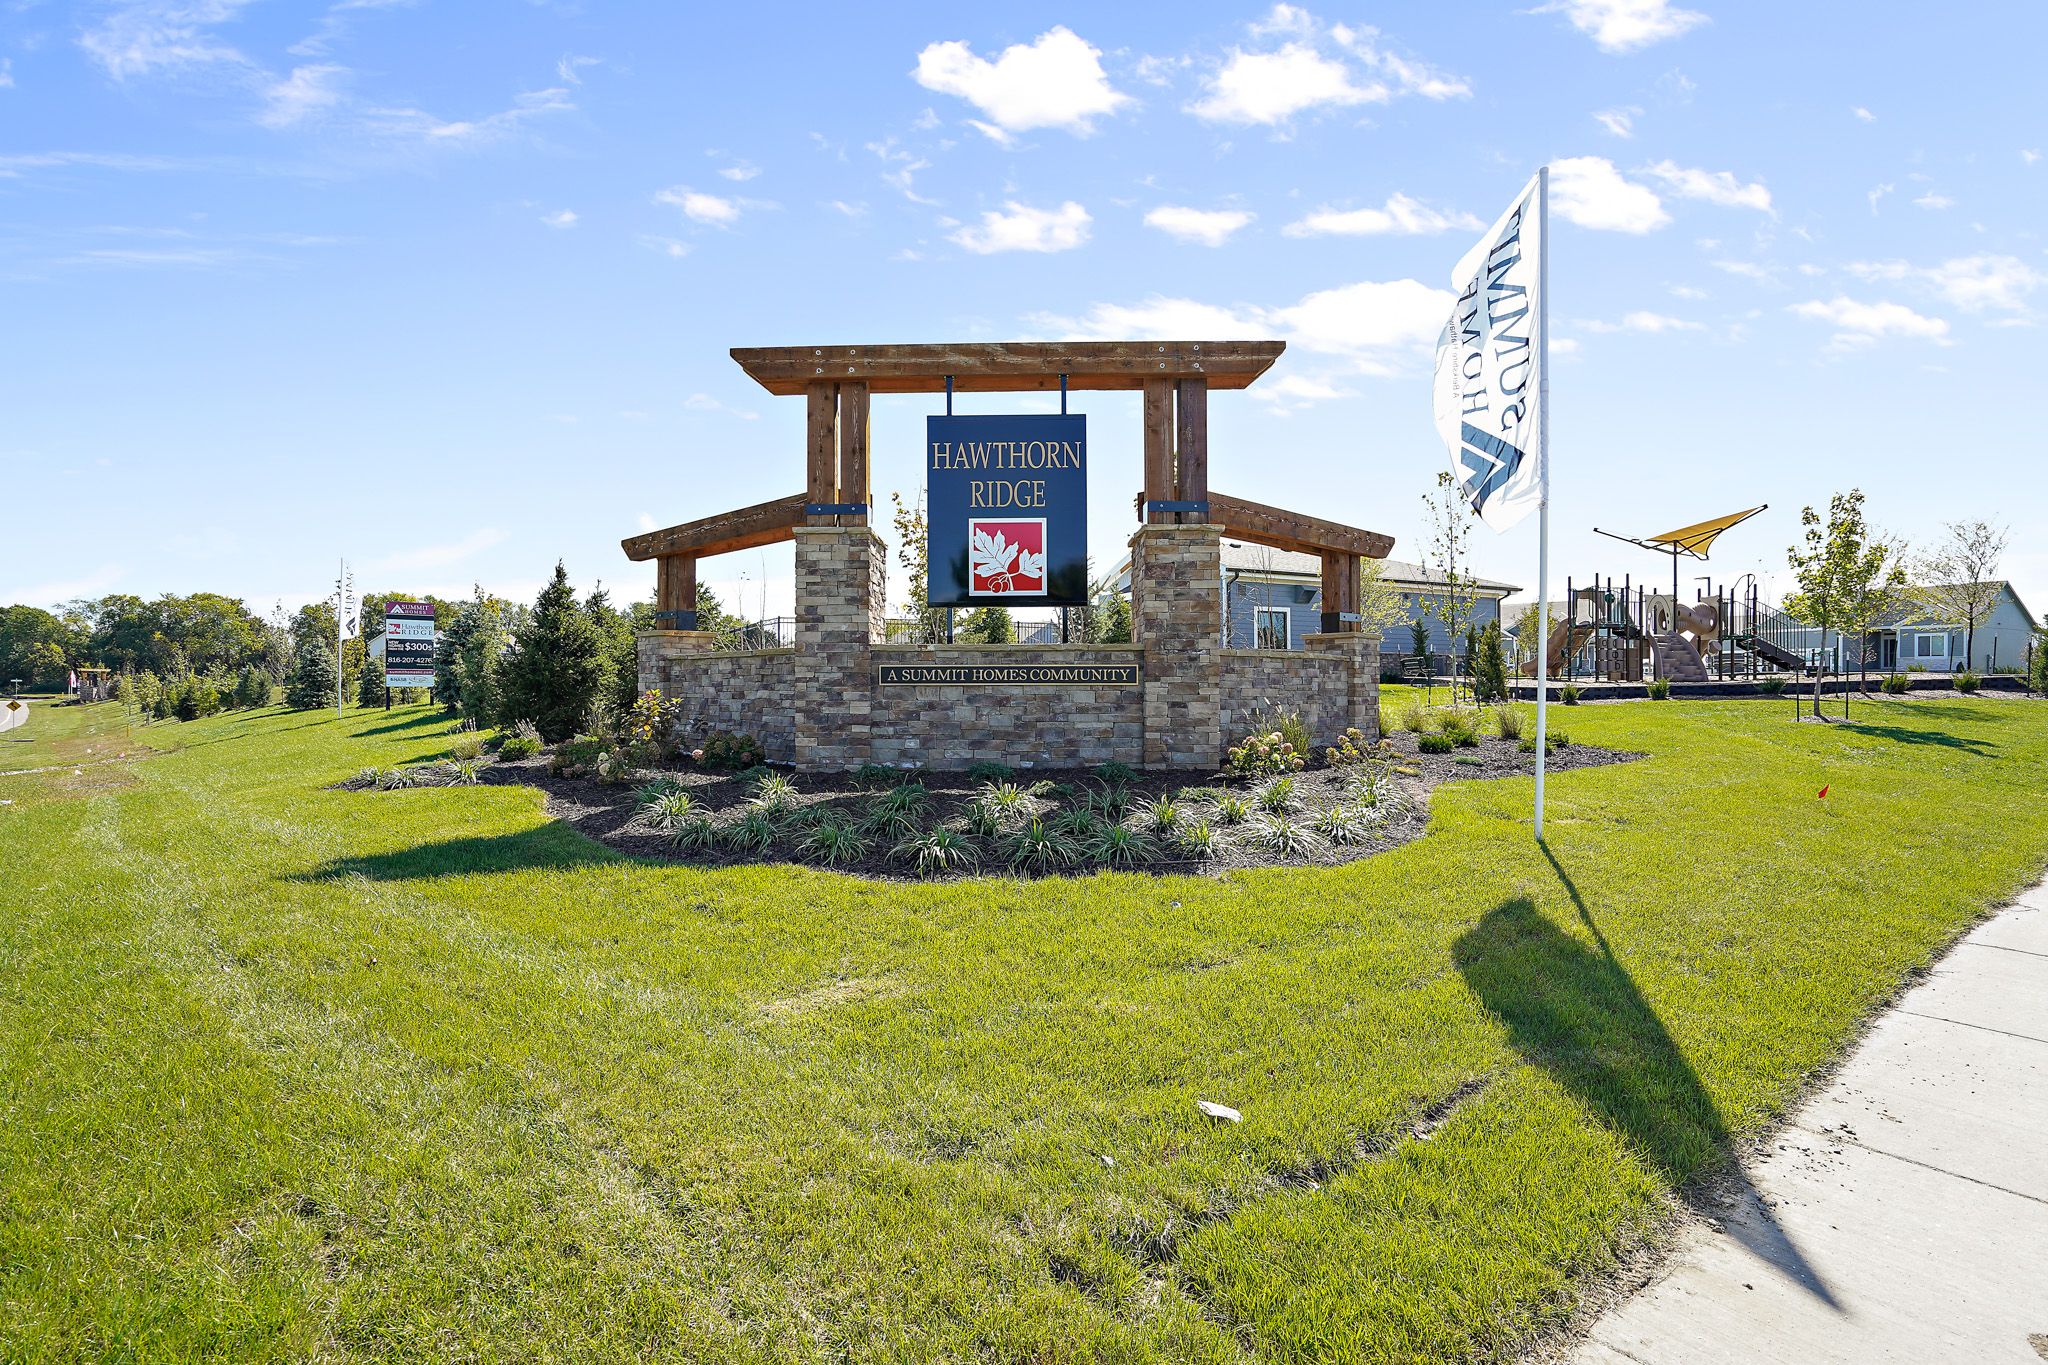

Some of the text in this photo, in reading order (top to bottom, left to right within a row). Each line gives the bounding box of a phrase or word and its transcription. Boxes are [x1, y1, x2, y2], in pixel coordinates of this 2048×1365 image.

[932, 441, 1082, 469] HAWTHORN
[969, 480, 1046, 508] RIDGE
[404, 641, 433, 651] $300s
[887, 669, 1130, 681] A SUMMIT HOMES COMMUNITY
